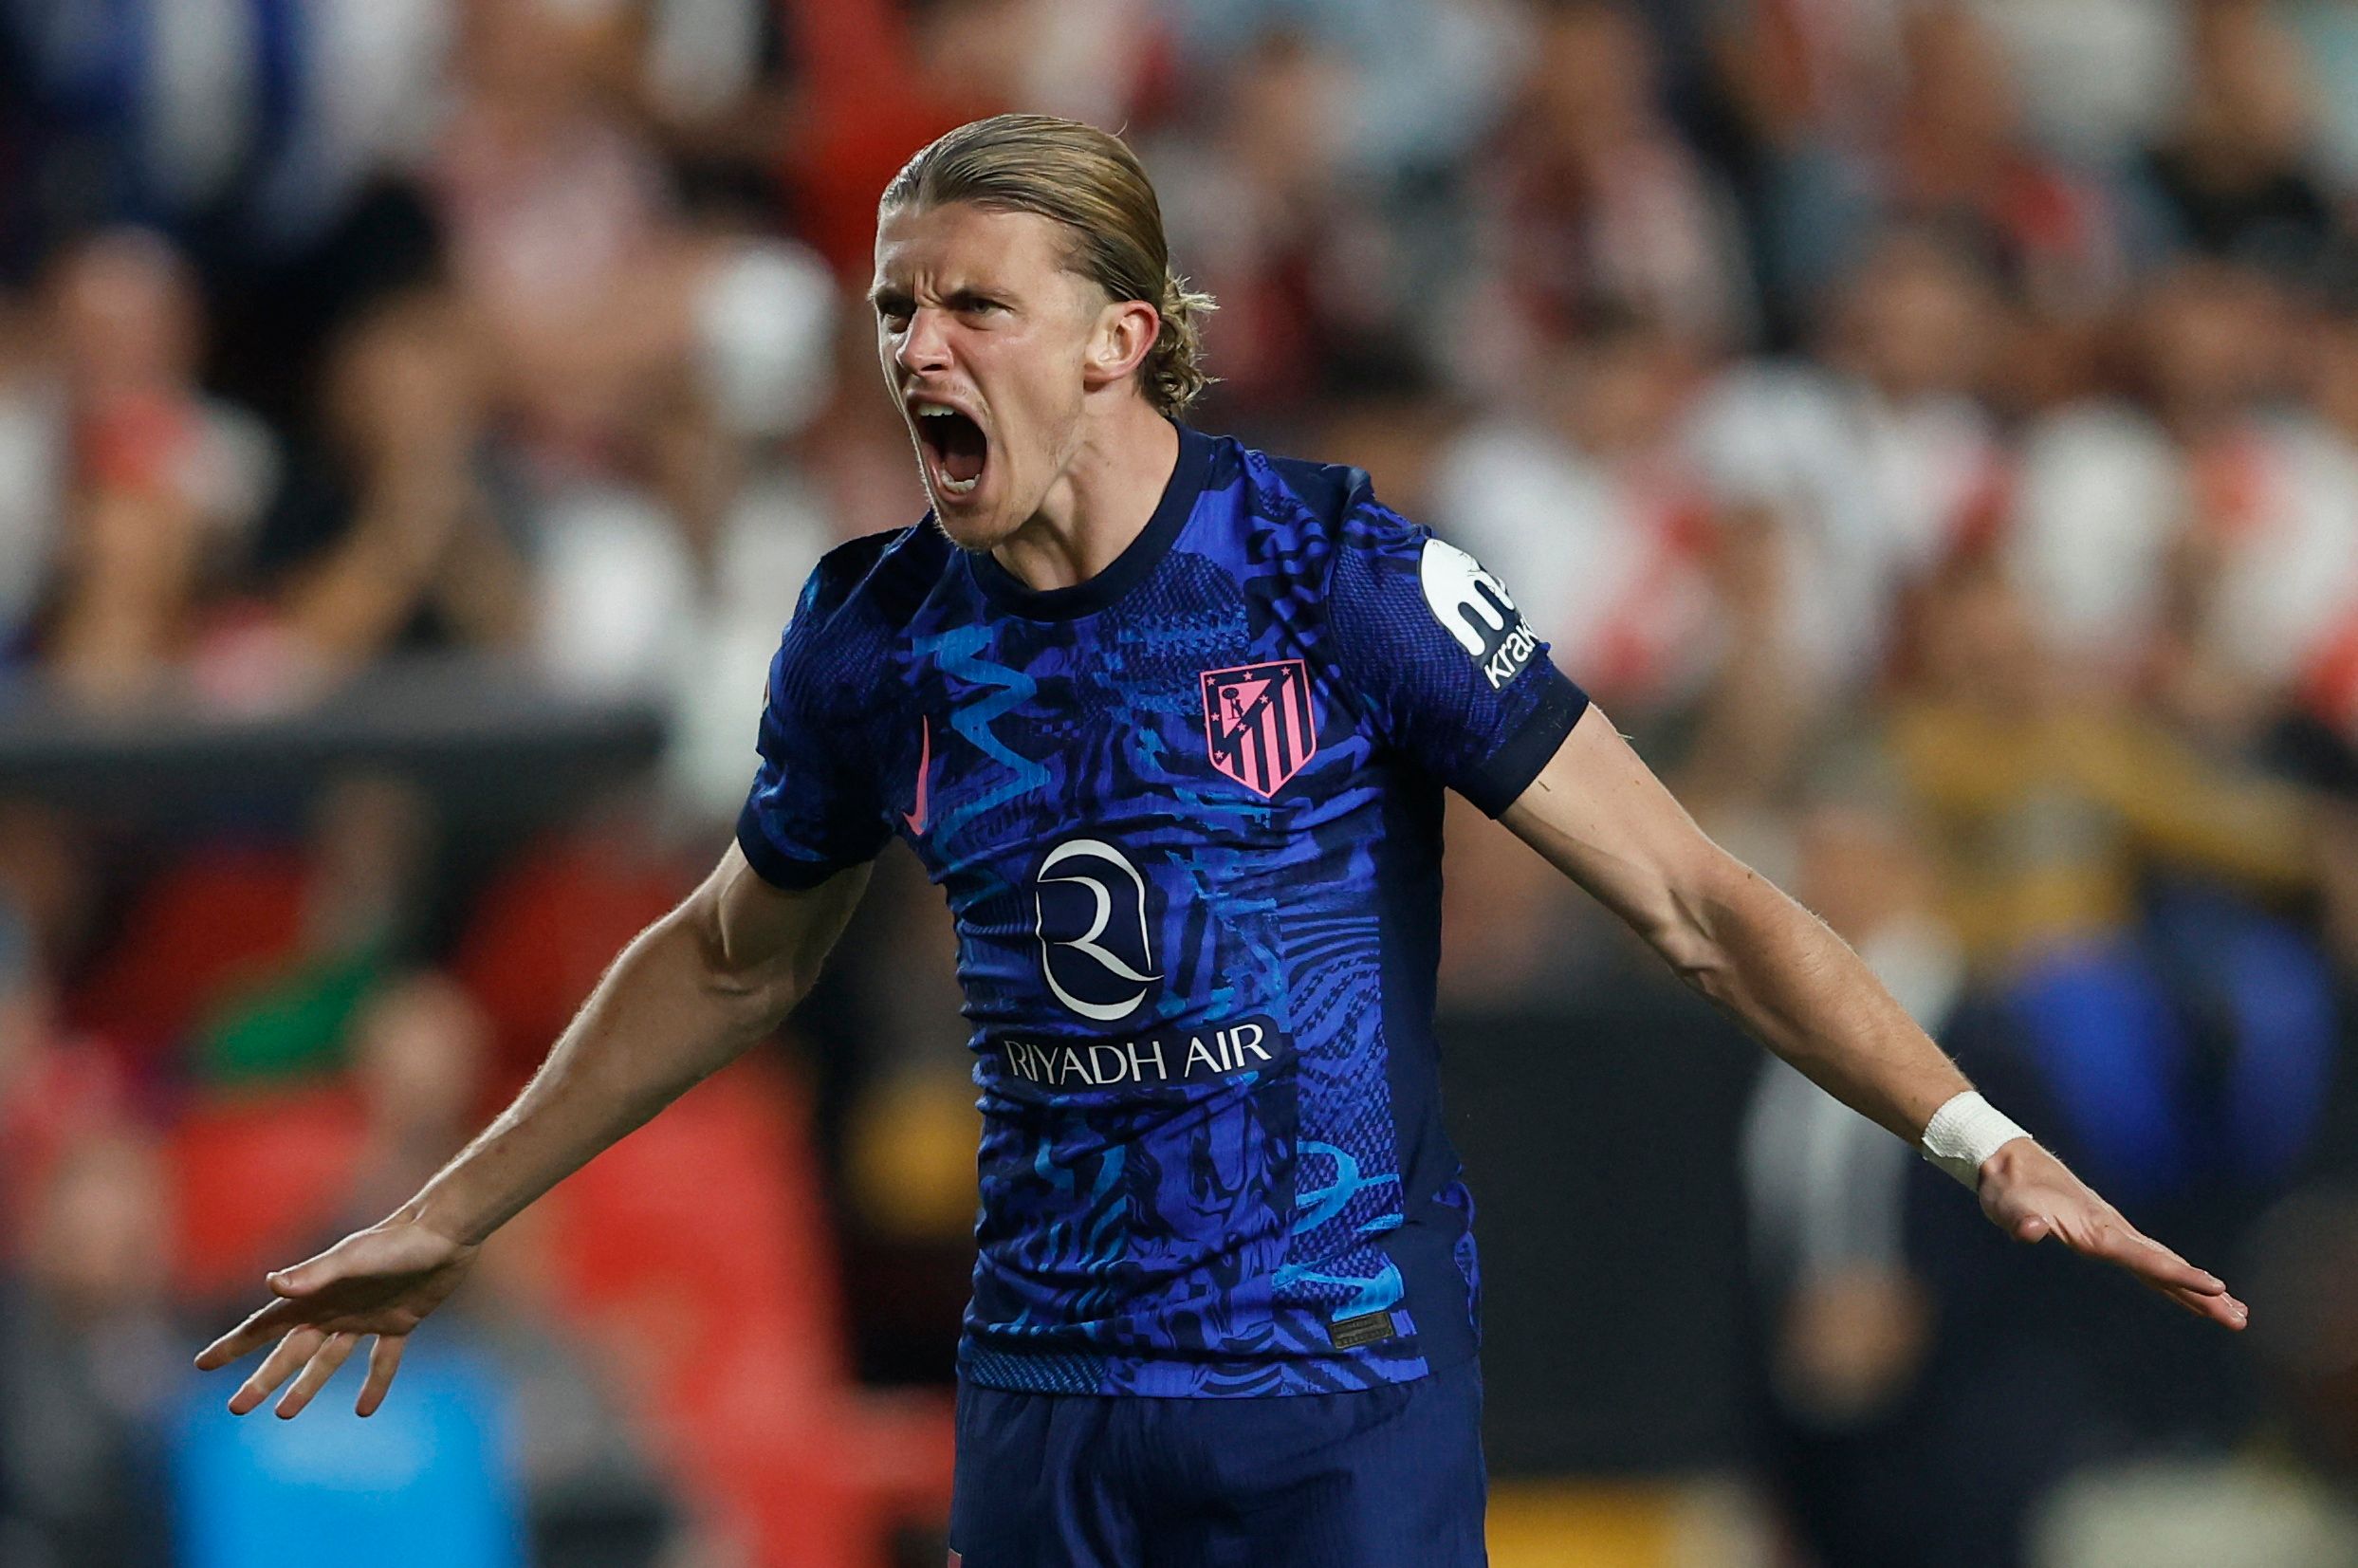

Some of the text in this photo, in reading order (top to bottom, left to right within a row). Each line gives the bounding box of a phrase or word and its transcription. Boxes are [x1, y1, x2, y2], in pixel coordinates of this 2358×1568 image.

[1483, 615, 1538, 689] krak
[1004, 1024, 1272, 1085] RIYADH AIR
